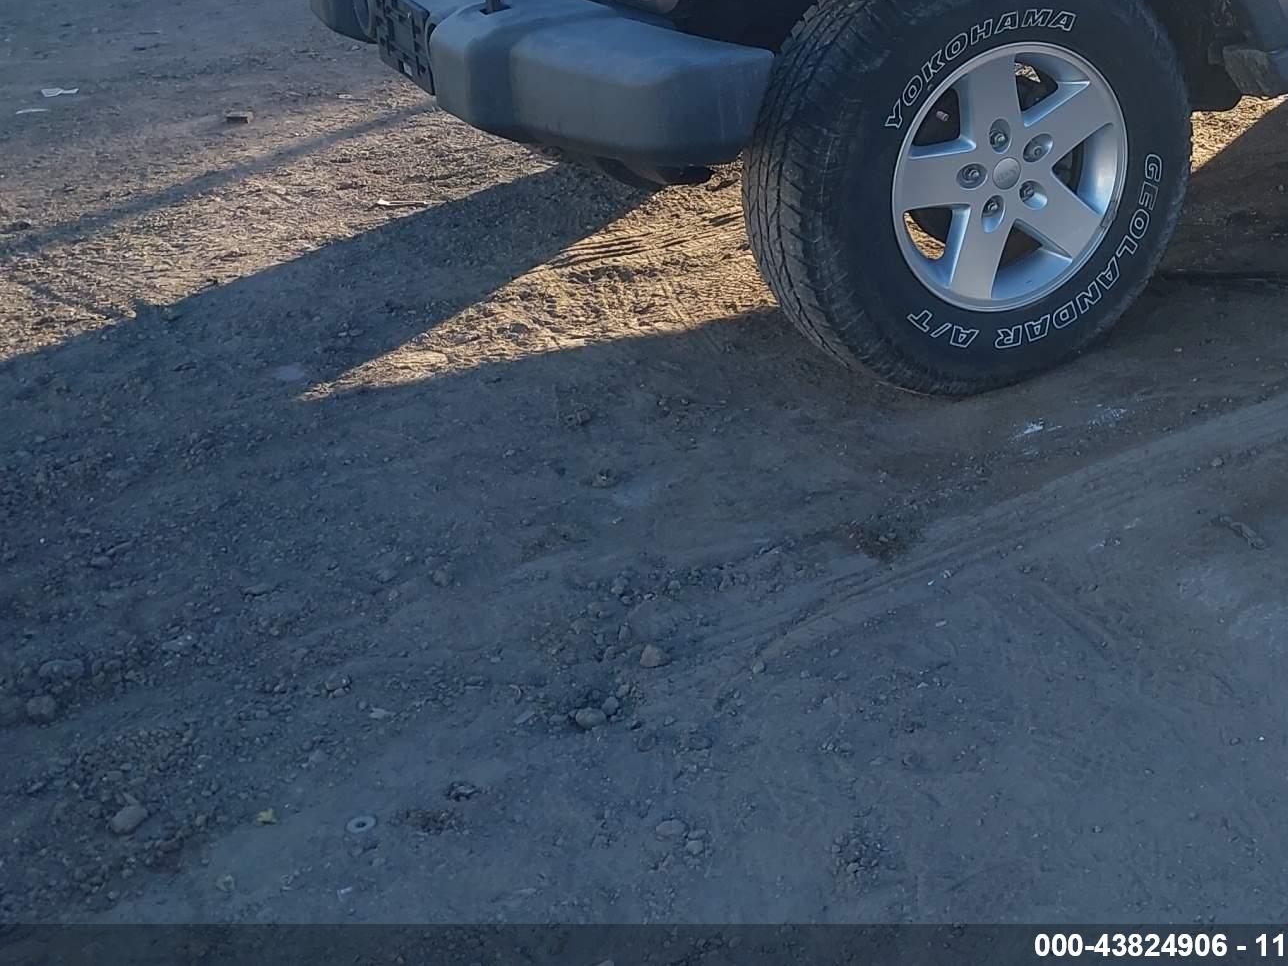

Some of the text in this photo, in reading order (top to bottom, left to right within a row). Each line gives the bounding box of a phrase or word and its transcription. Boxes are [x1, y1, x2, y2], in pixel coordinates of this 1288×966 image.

[885, 9, 1077, 129] YOKOHAMA
[908, 153, 1162, 349] GEOLANDAR A/T
